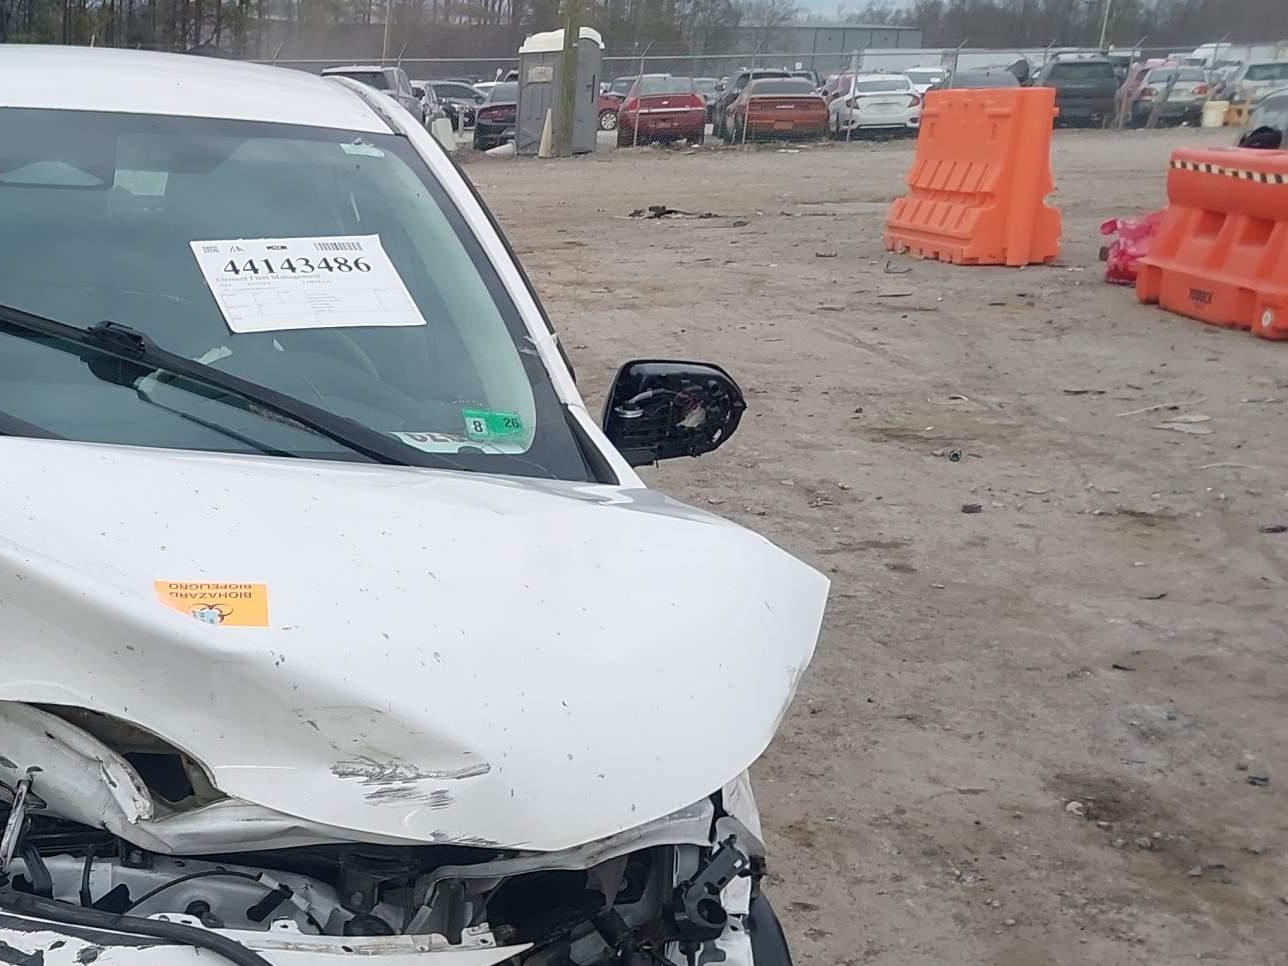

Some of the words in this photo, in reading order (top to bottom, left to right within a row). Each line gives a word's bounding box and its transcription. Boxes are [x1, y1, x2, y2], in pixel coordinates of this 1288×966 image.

[223, 257, 372, 275] 44143486
[472, 420, 483, 433] 8
[504, 417, 520, 428] 26
[168, 583, 252, 591] BIOPELIGRO
[169, 591, 252, 599] BIOHAZARD
